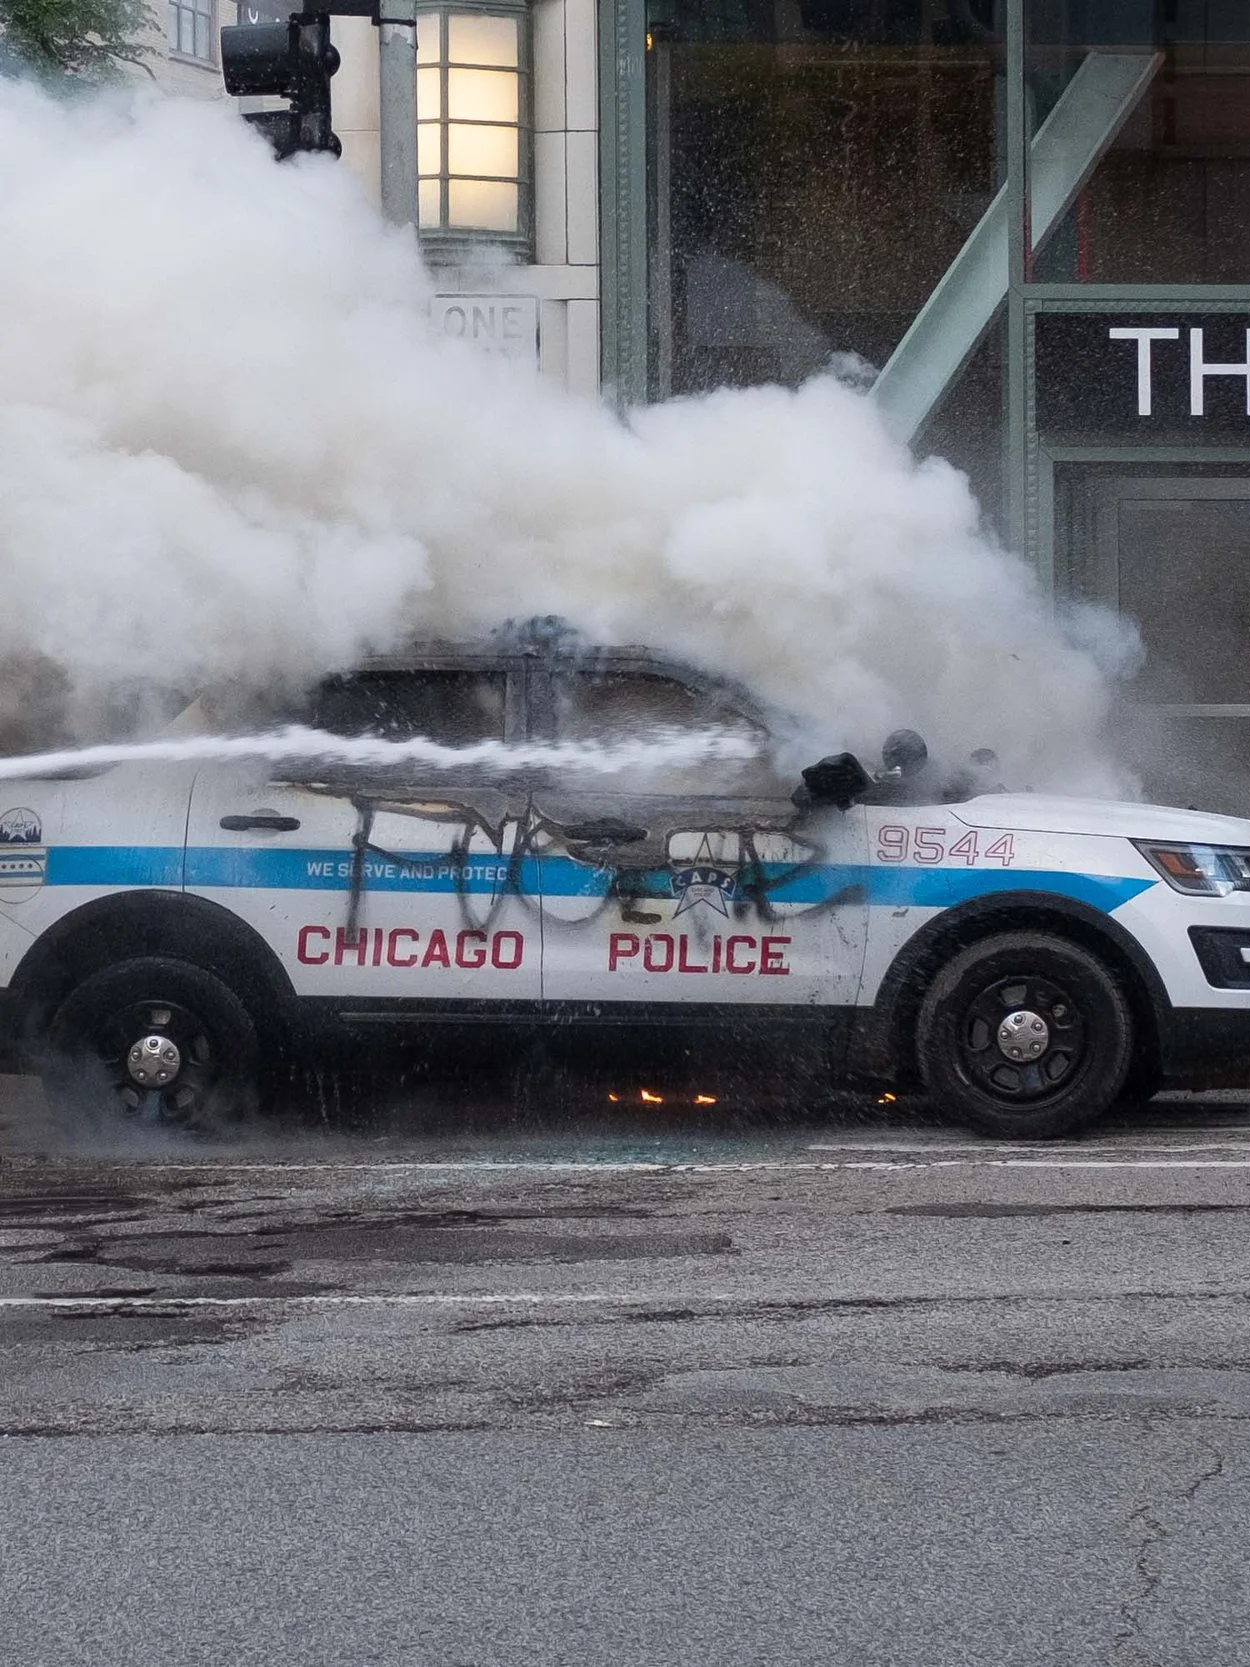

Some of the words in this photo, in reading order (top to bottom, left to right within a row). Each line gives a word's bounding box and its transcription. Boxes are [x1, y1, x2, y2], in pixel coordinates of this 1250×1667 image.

[443, 305, 523, 340] ONE
[877, 825, 1015, 866] 9544
[307, 862, 333, 876] WE
[338, 863, 395, 879] SRVE
[400, 864, 434, 880] AND
[438, 865, 517, 881] PROTEC
[676, 871, 731, 888] CAPS
[297, 925, 524, 970] CHICAGO
[608, 933, 792, 975] POLICE
